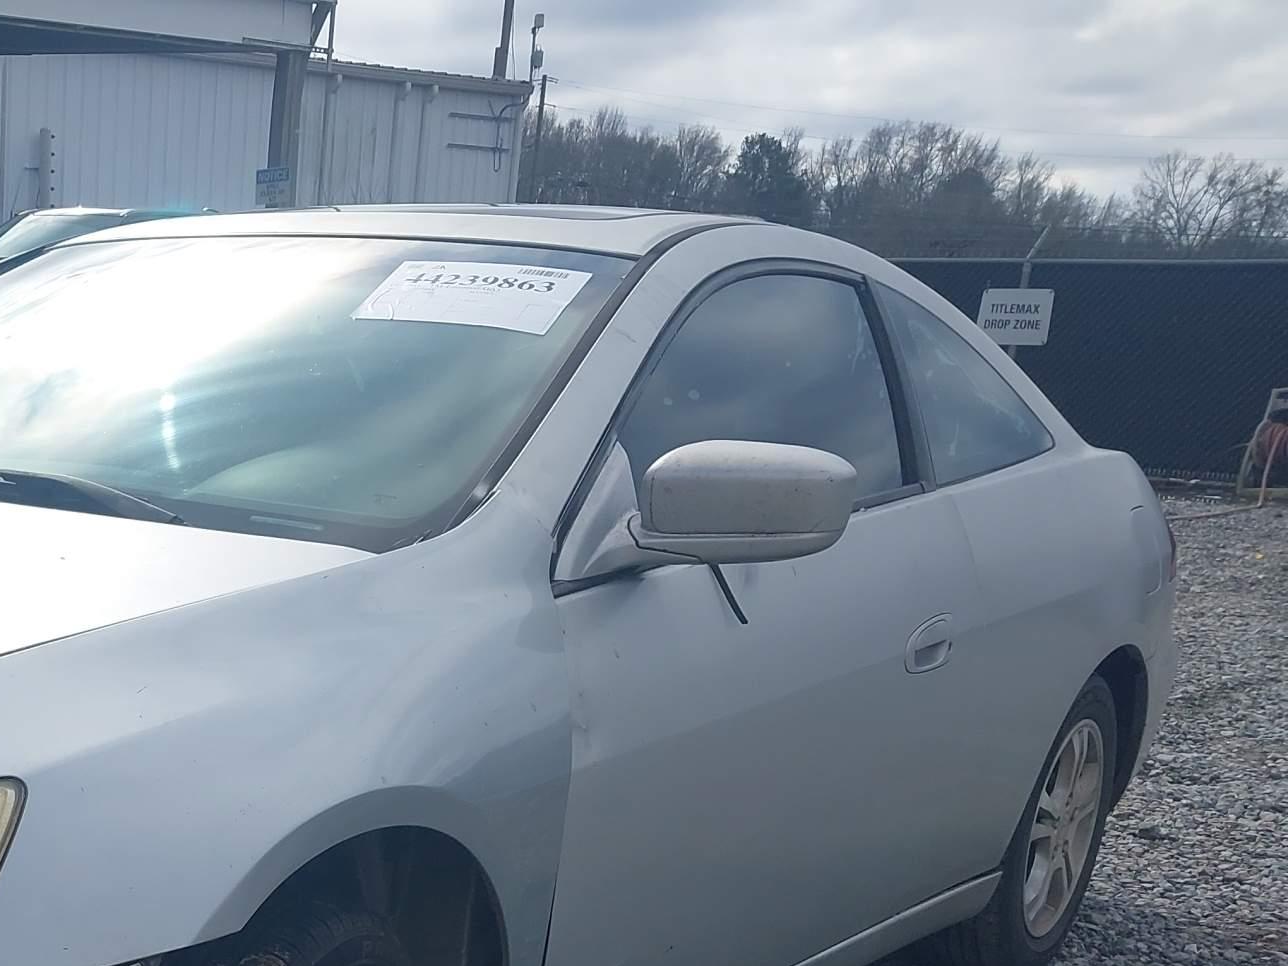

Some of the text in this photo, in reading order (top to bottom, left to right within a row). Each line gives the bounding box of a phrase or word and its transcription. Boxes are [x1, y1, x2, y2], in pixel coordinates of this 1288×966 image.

[257, 169, 288, 183] NOTICE
[405, 272, 556, 293] 44239863
[991, 303, 1041, 314] TITLEMAX
[983, 319, 1041, 330] DROP ZONE
